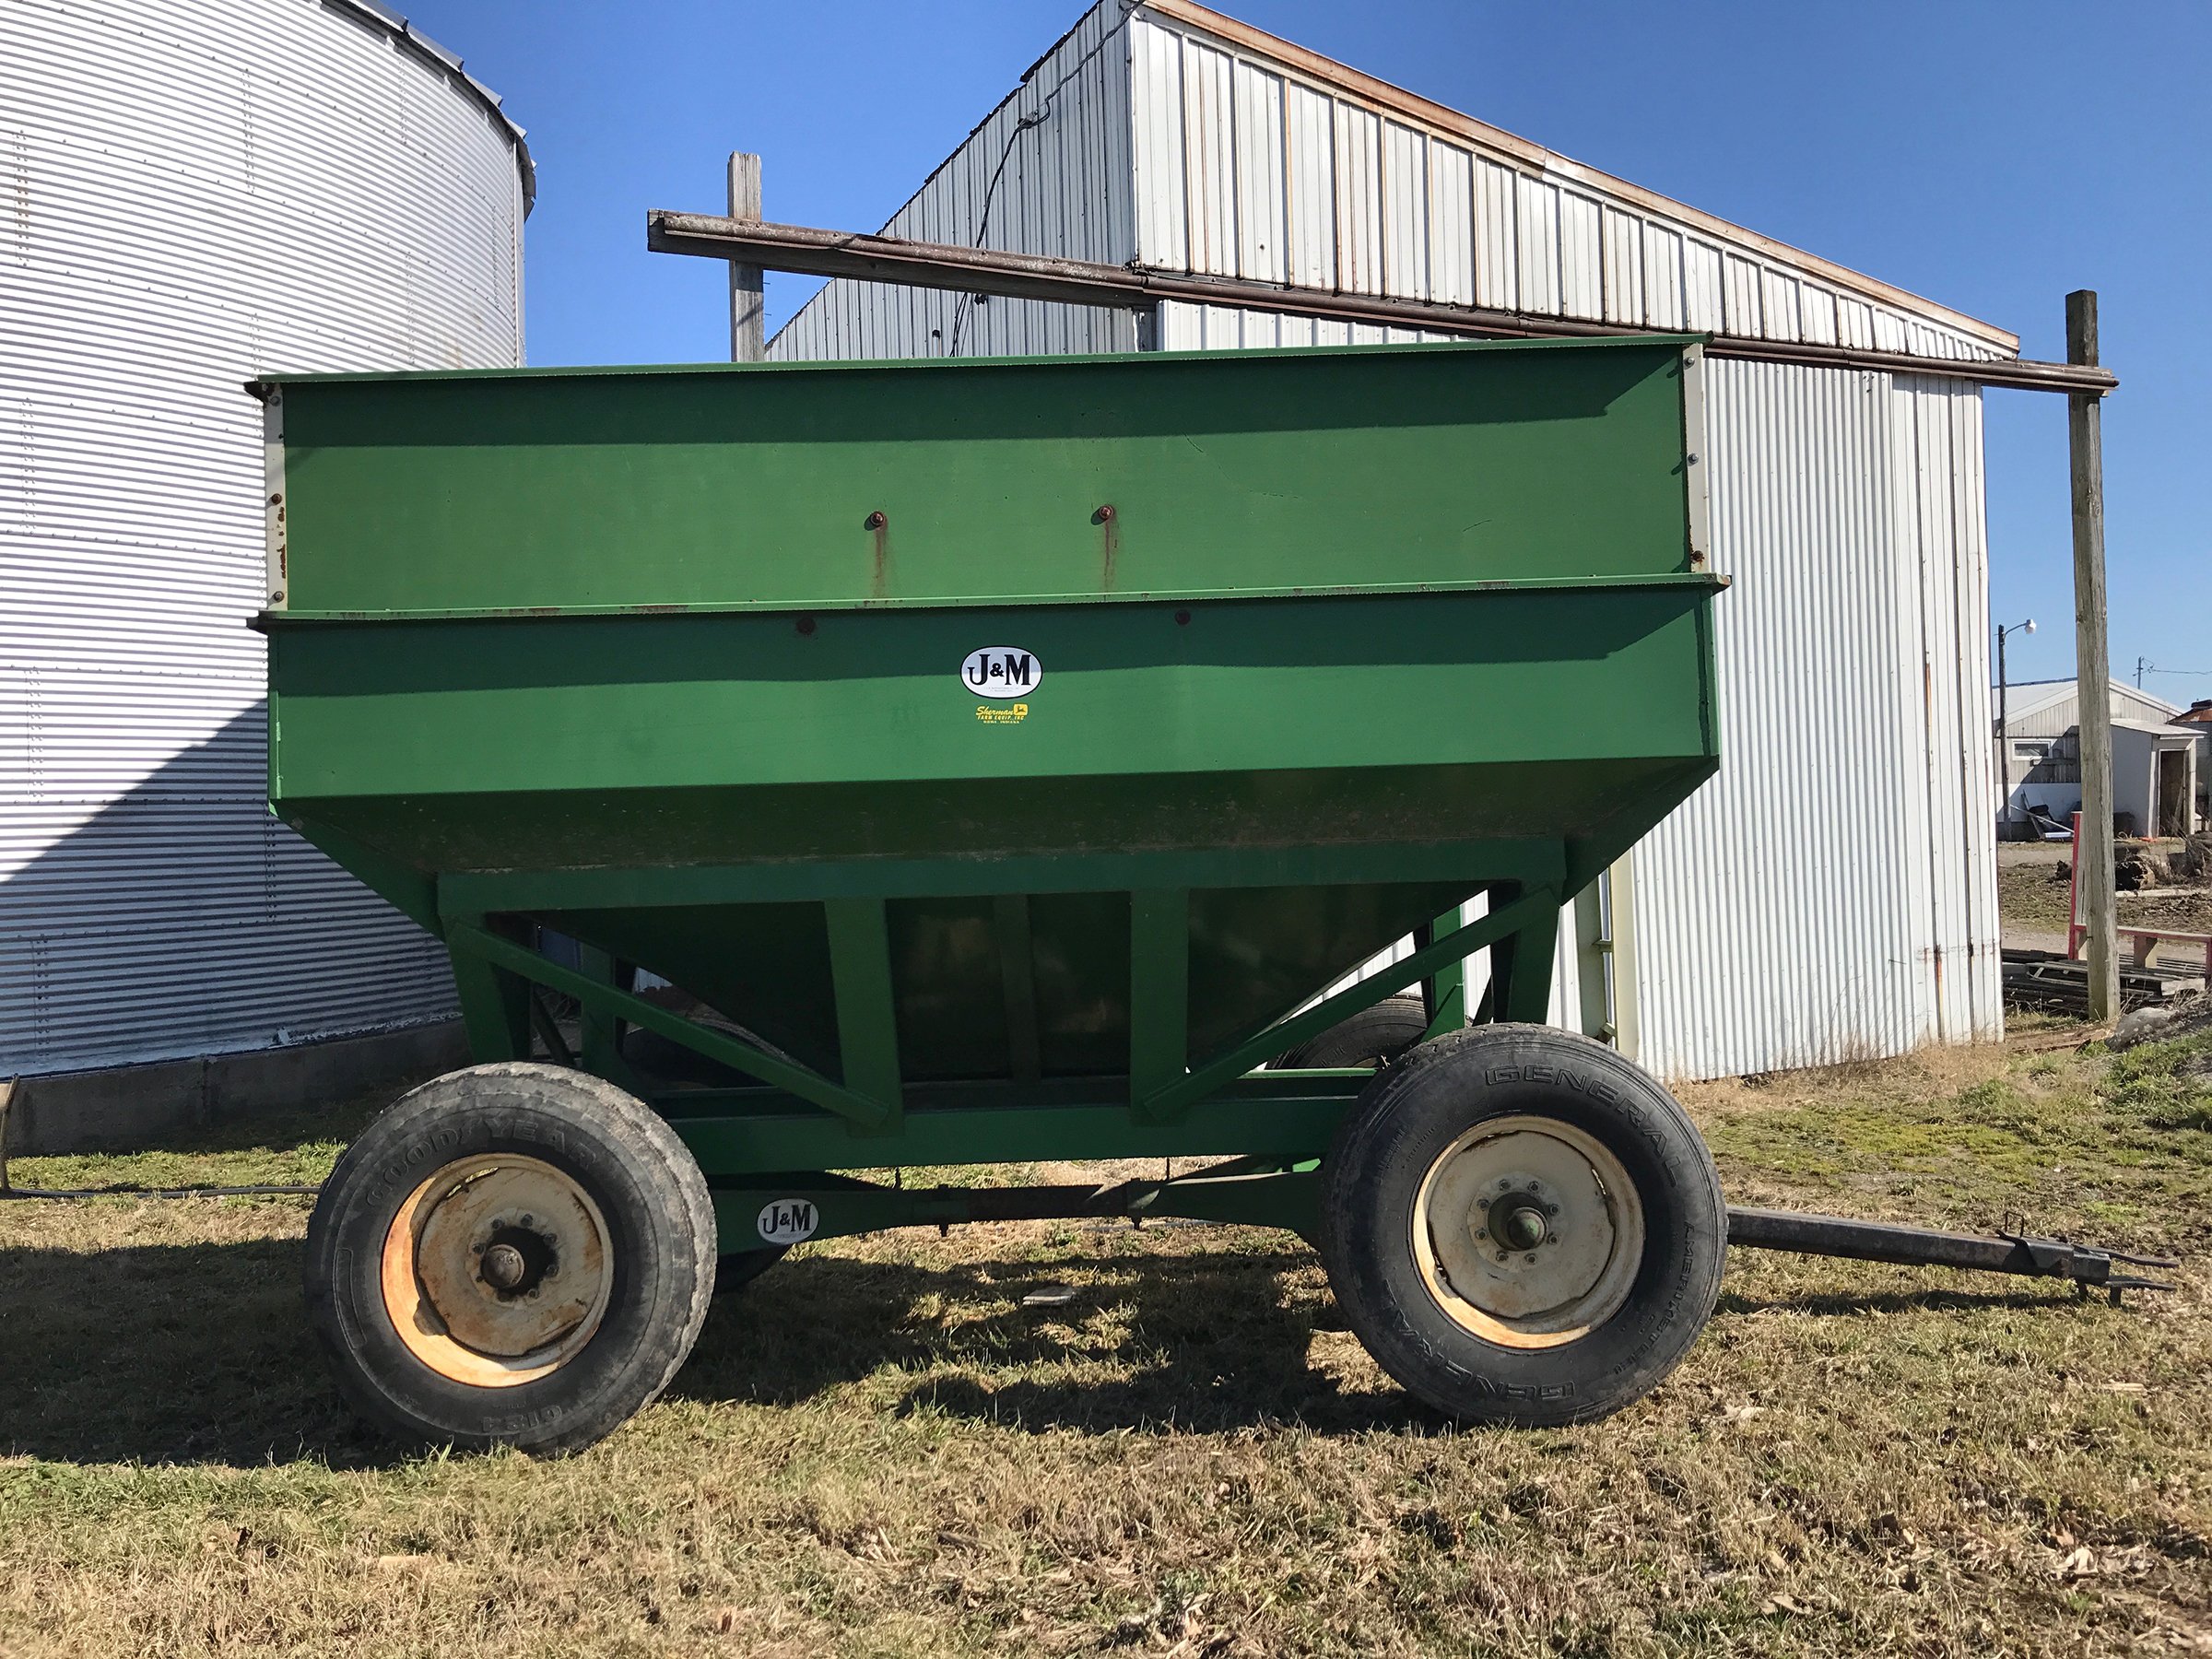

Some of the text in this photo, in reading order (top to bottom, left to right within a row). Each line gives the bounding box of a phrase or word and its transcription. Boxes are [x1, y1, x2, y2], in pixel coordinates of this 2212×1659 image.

[967, 653, 1031, 686] J&M
[976, 706, 1014, 715] Sherman
[1485, 1065, 1683, 1188] GENERAL
[762, 1203, 812, 1234] J&M
[1380, 1279, 1576, 1401] GENERAL
